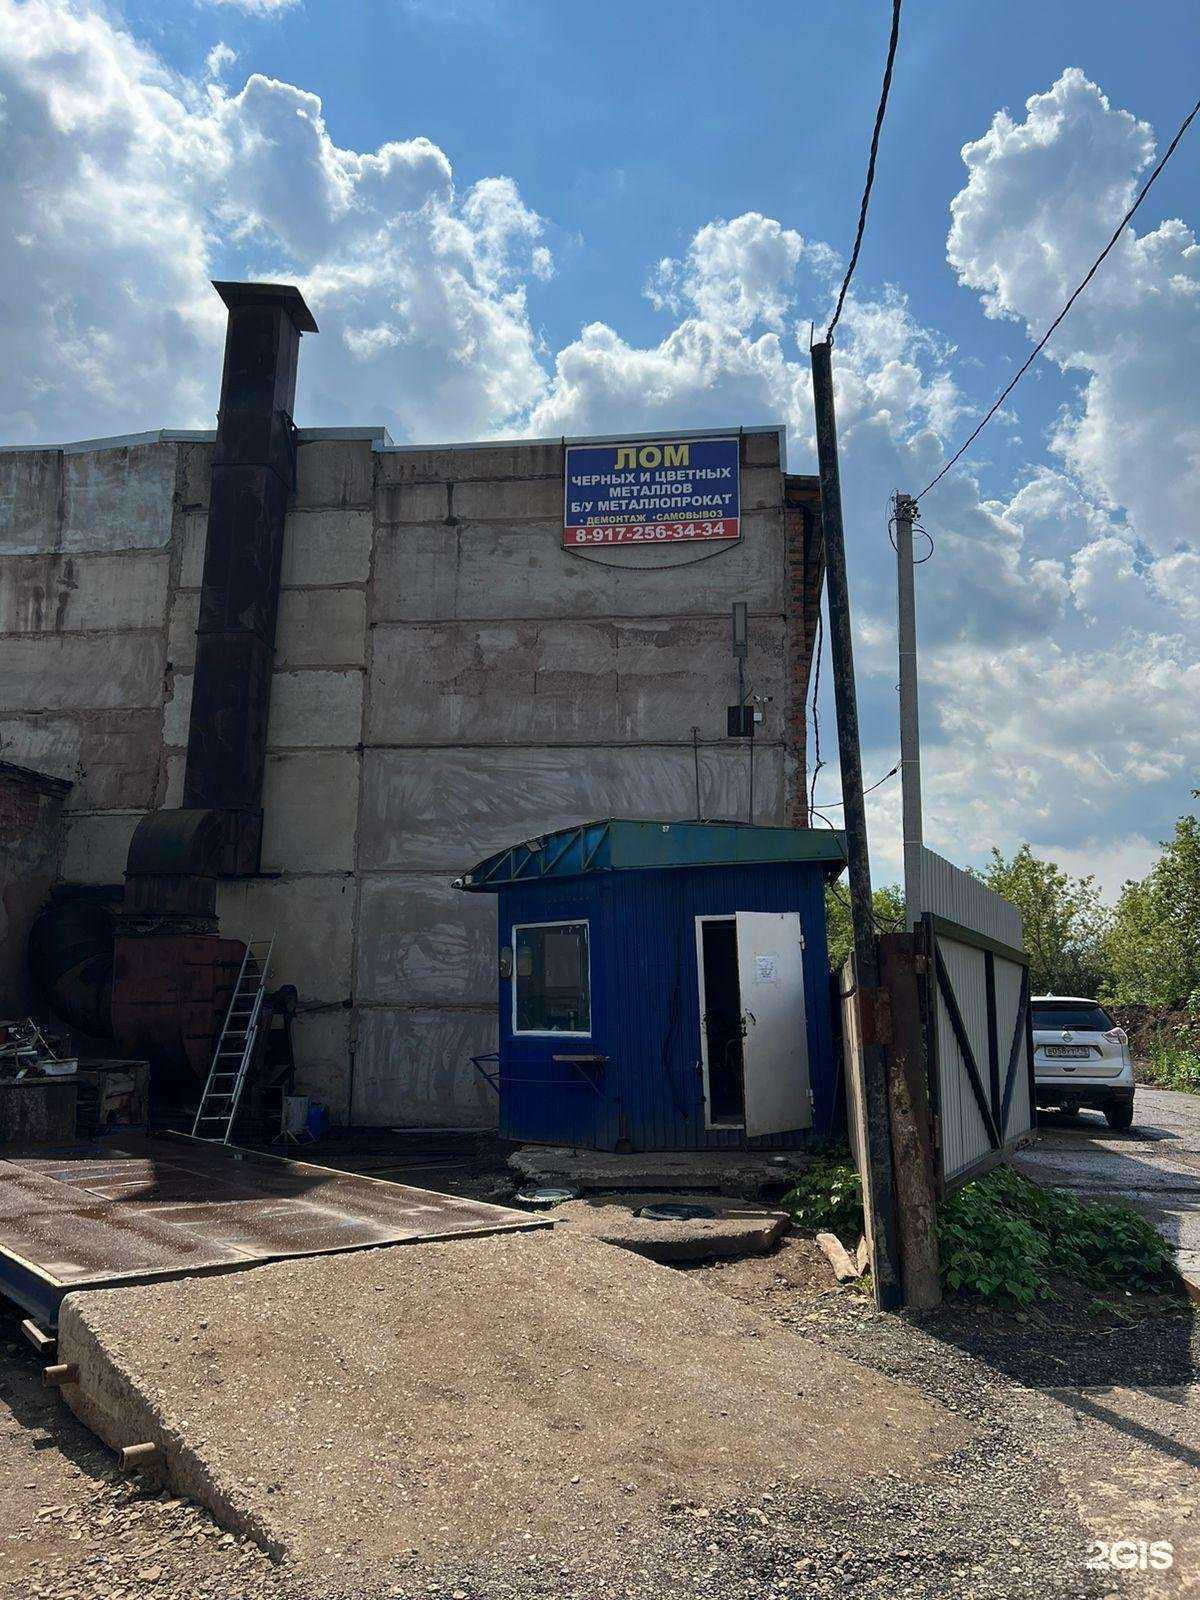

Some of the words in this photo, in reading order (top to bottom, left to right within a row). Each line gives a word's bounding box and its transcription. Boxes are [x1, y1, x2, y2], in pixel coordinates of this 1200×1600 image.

[615, 445, 689, 470] ЛОМ
[572, 473, 635, 486] ЧЕРНЫХ
[640, 473, 650, 482] И
[656, 467, 731, 483] ЦВЕТНЫХ
[609, 483, 692, 497] МЕТАЛЛОВ
[572, 502, 593, 512] Б/У
[598, 494, 732, 511] МЕТАЛЛОПРОКАТ
[576, 522, 725, 542] 8-917-256-34-34
